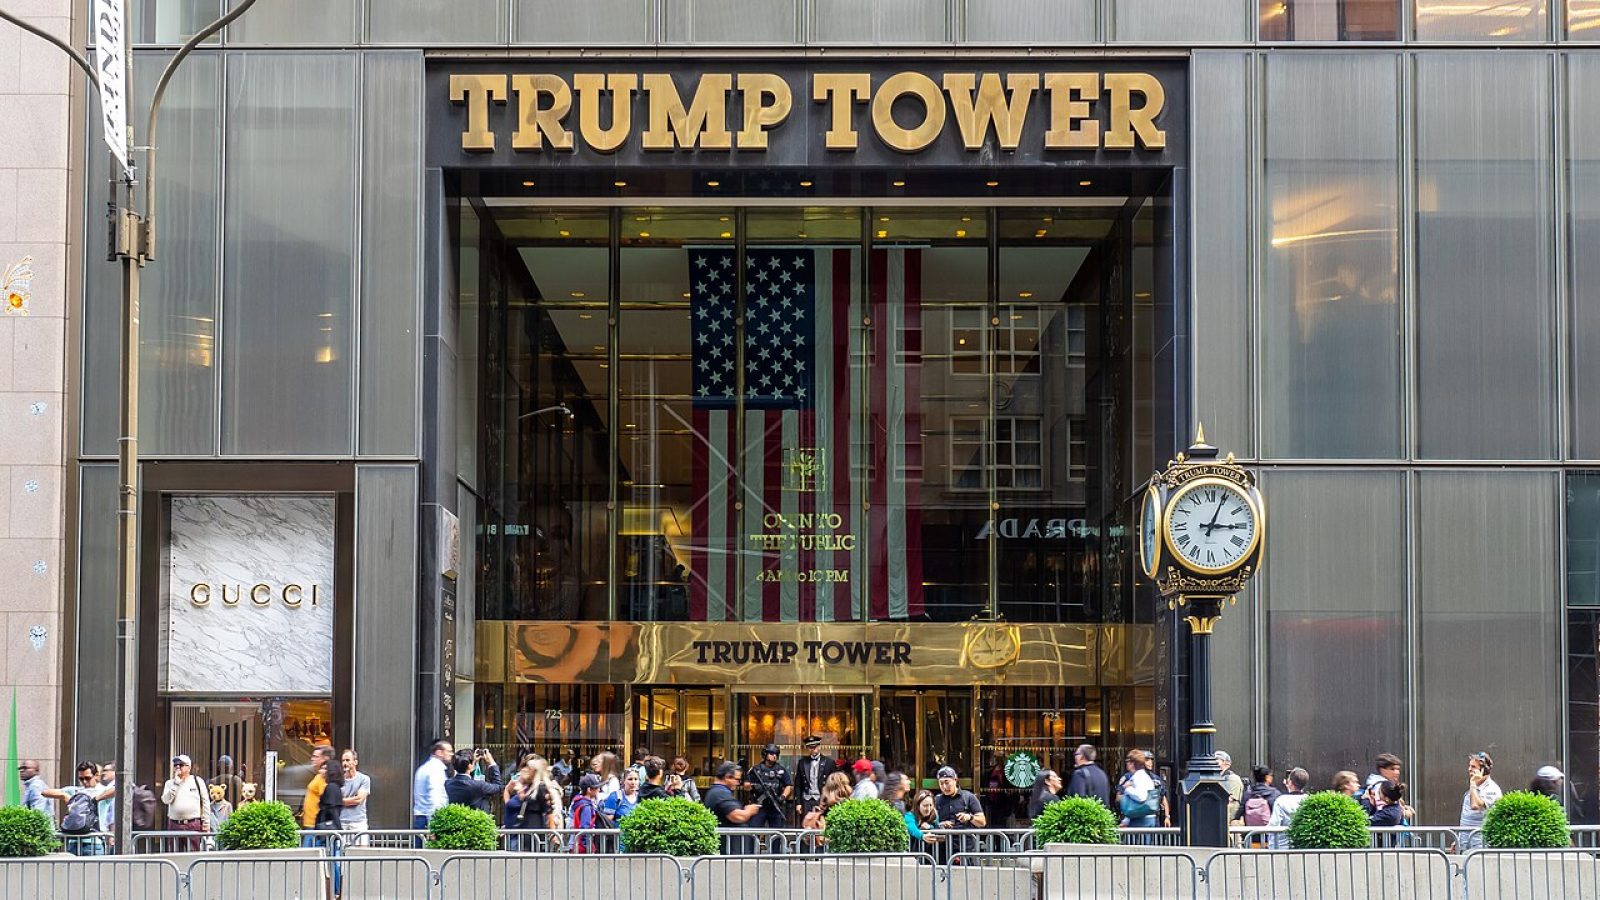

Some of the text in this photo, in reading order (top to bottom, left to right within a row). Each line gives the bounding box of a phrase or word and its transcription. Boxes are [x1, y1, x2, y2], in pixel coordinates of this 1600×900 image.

[449, 71, 1167, 151] TRUMP TOWER
[1179, 467, 1241, 481] TRUMP TOWER
[816, 513, 842, 529] TO
[750, 534, 787, 551] THE
[190, 583, 319, 607] GUCCI
[693, 640, 912, 664] TRUMP TOWER
[545, 709, 563, 720] 725
[1042, 711, 1061, 722] 725
